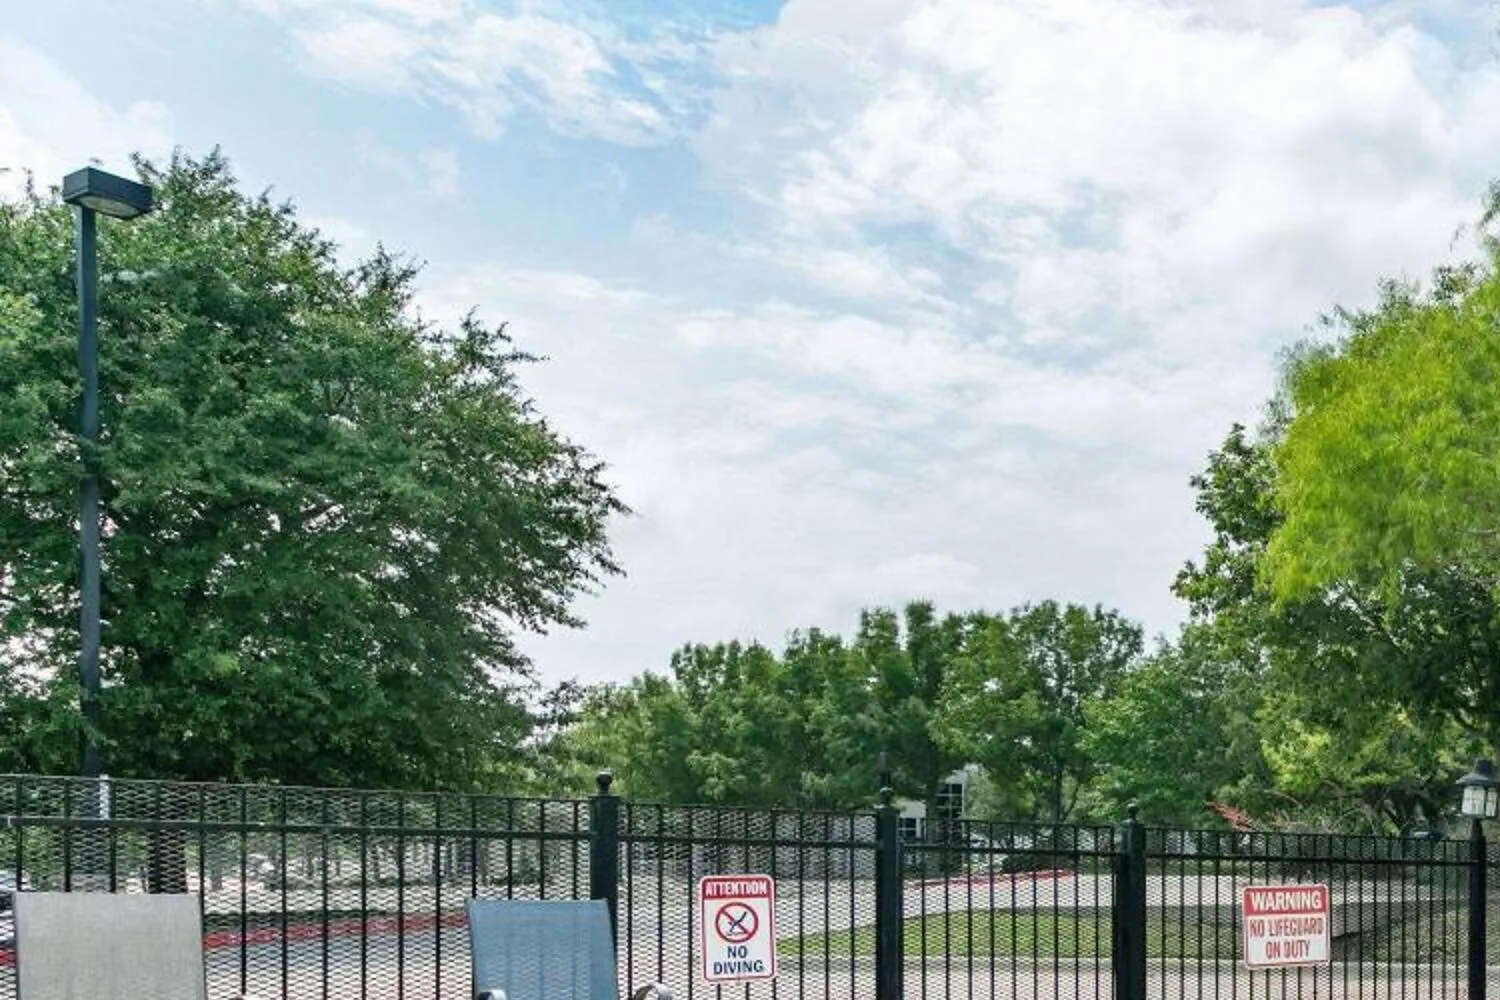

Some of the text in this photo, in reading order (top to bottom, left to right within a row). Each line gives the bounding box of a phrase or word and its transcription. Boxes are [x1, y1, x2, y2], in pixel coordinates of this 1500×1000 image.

[705, 880, 767, 897] ATTENTION
[1250, 890, 1322, 911] WARNING
[1249, 917, 1324, 938] NO LIFEGUARD
[727, 945, 748, 959] NO
[1265, 939, 1311, 959] ON DUTY
[713, 960, 764, 975] DIVING
